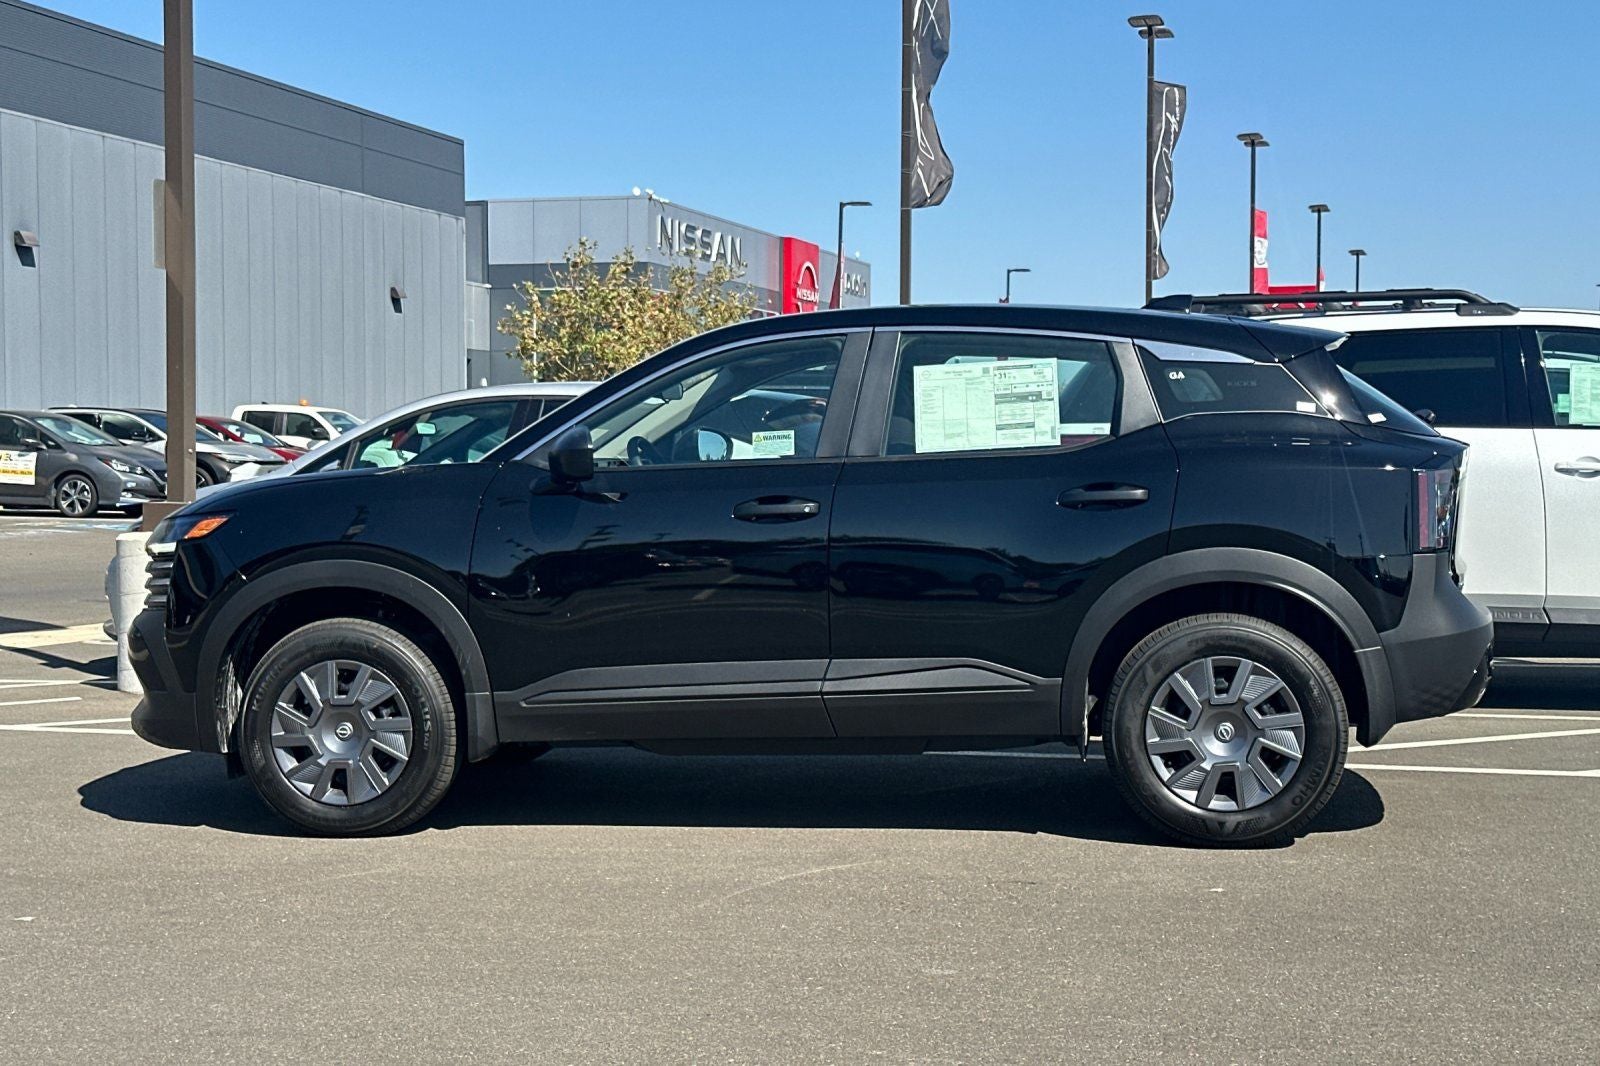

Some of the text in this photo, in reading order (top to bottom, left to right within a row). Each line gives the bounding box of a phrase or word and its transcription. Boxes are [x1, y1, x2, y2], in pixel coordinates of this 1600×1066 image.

[656, 214, 743, 269] NISSAN
[796, 287, 820, 304] NISSAN
[762, 433, 792, 441] WARNING
